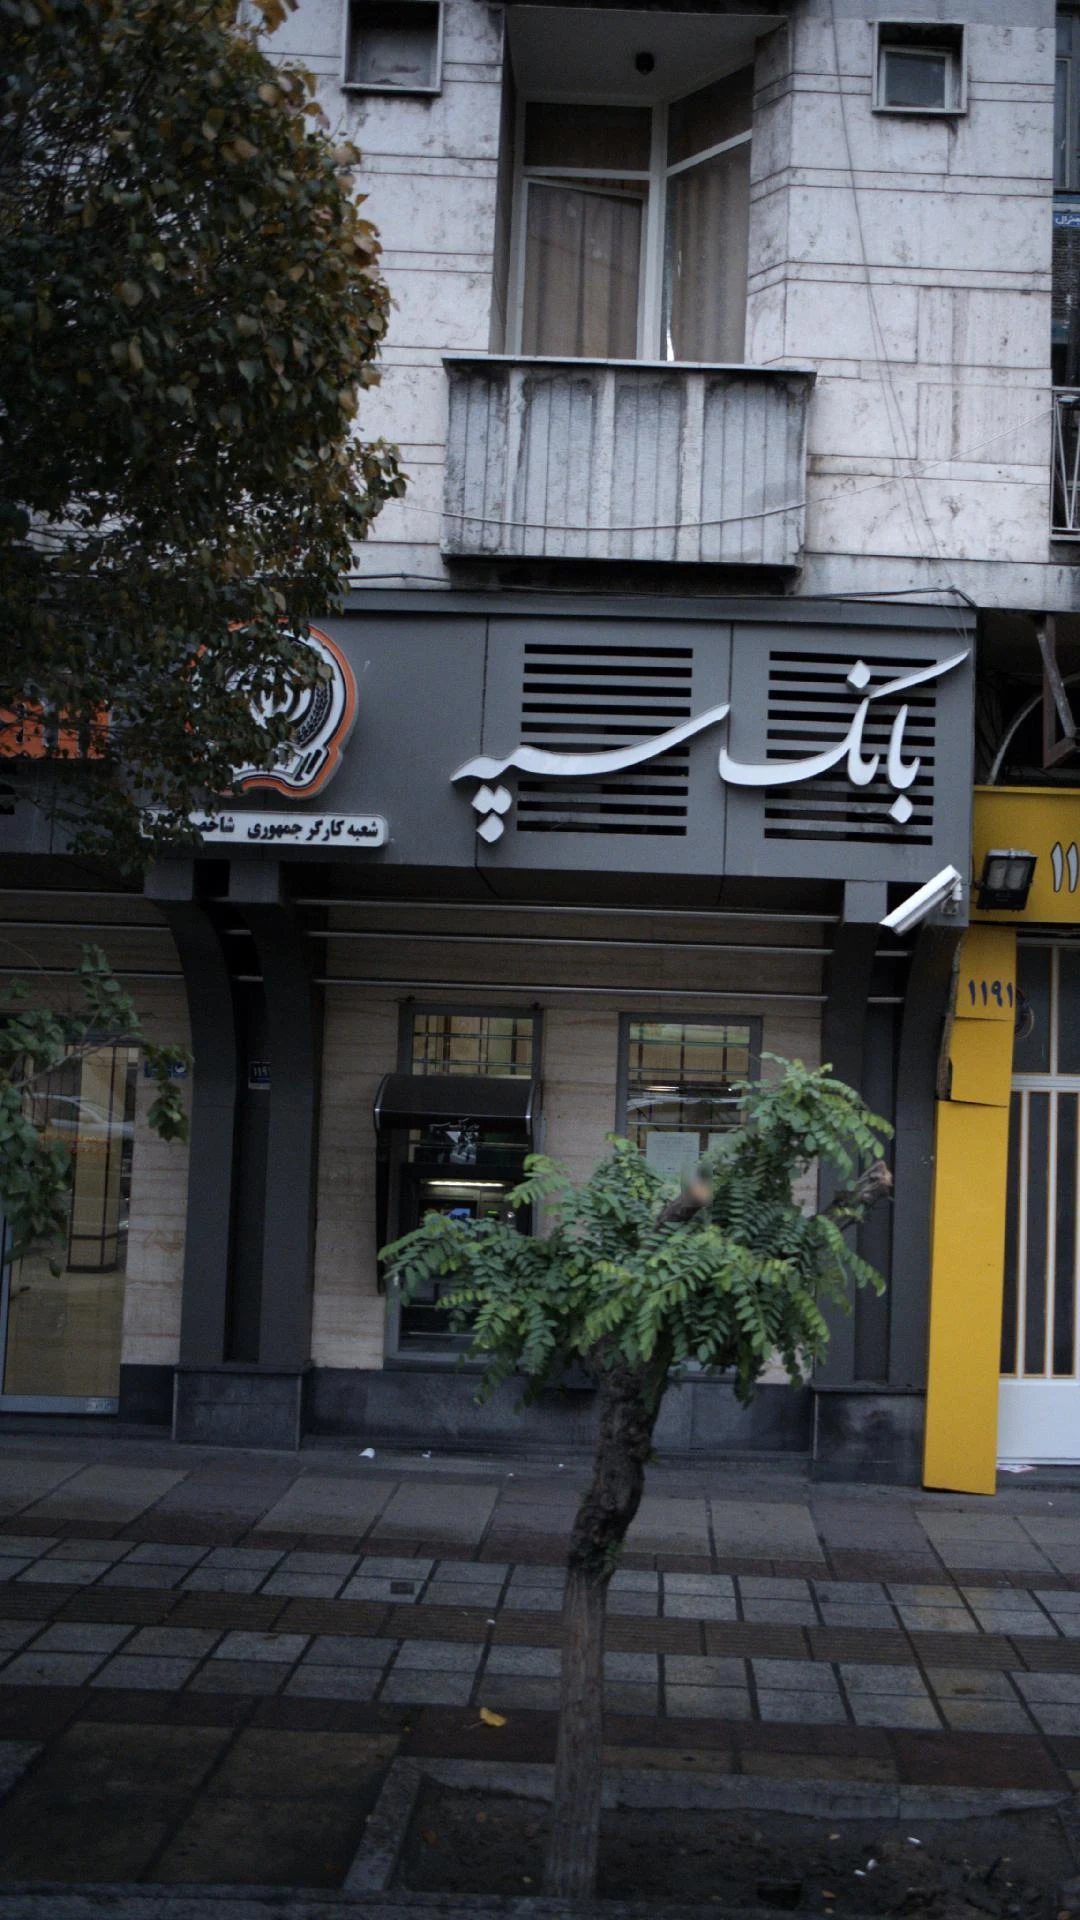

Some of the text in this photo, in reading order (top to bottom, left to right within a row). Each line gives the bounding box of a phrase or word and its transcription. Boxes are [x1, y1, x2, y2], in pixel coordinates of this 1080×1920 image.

[450, 649, 969, 843] بانک سپه
[247, 822, 302, 841] جمهوری
[307, 820, 345, 842] کارگر
[347, 821, 379, 841] شعبه
[968, 979, 1014, 1009] ۱۱۹۱
